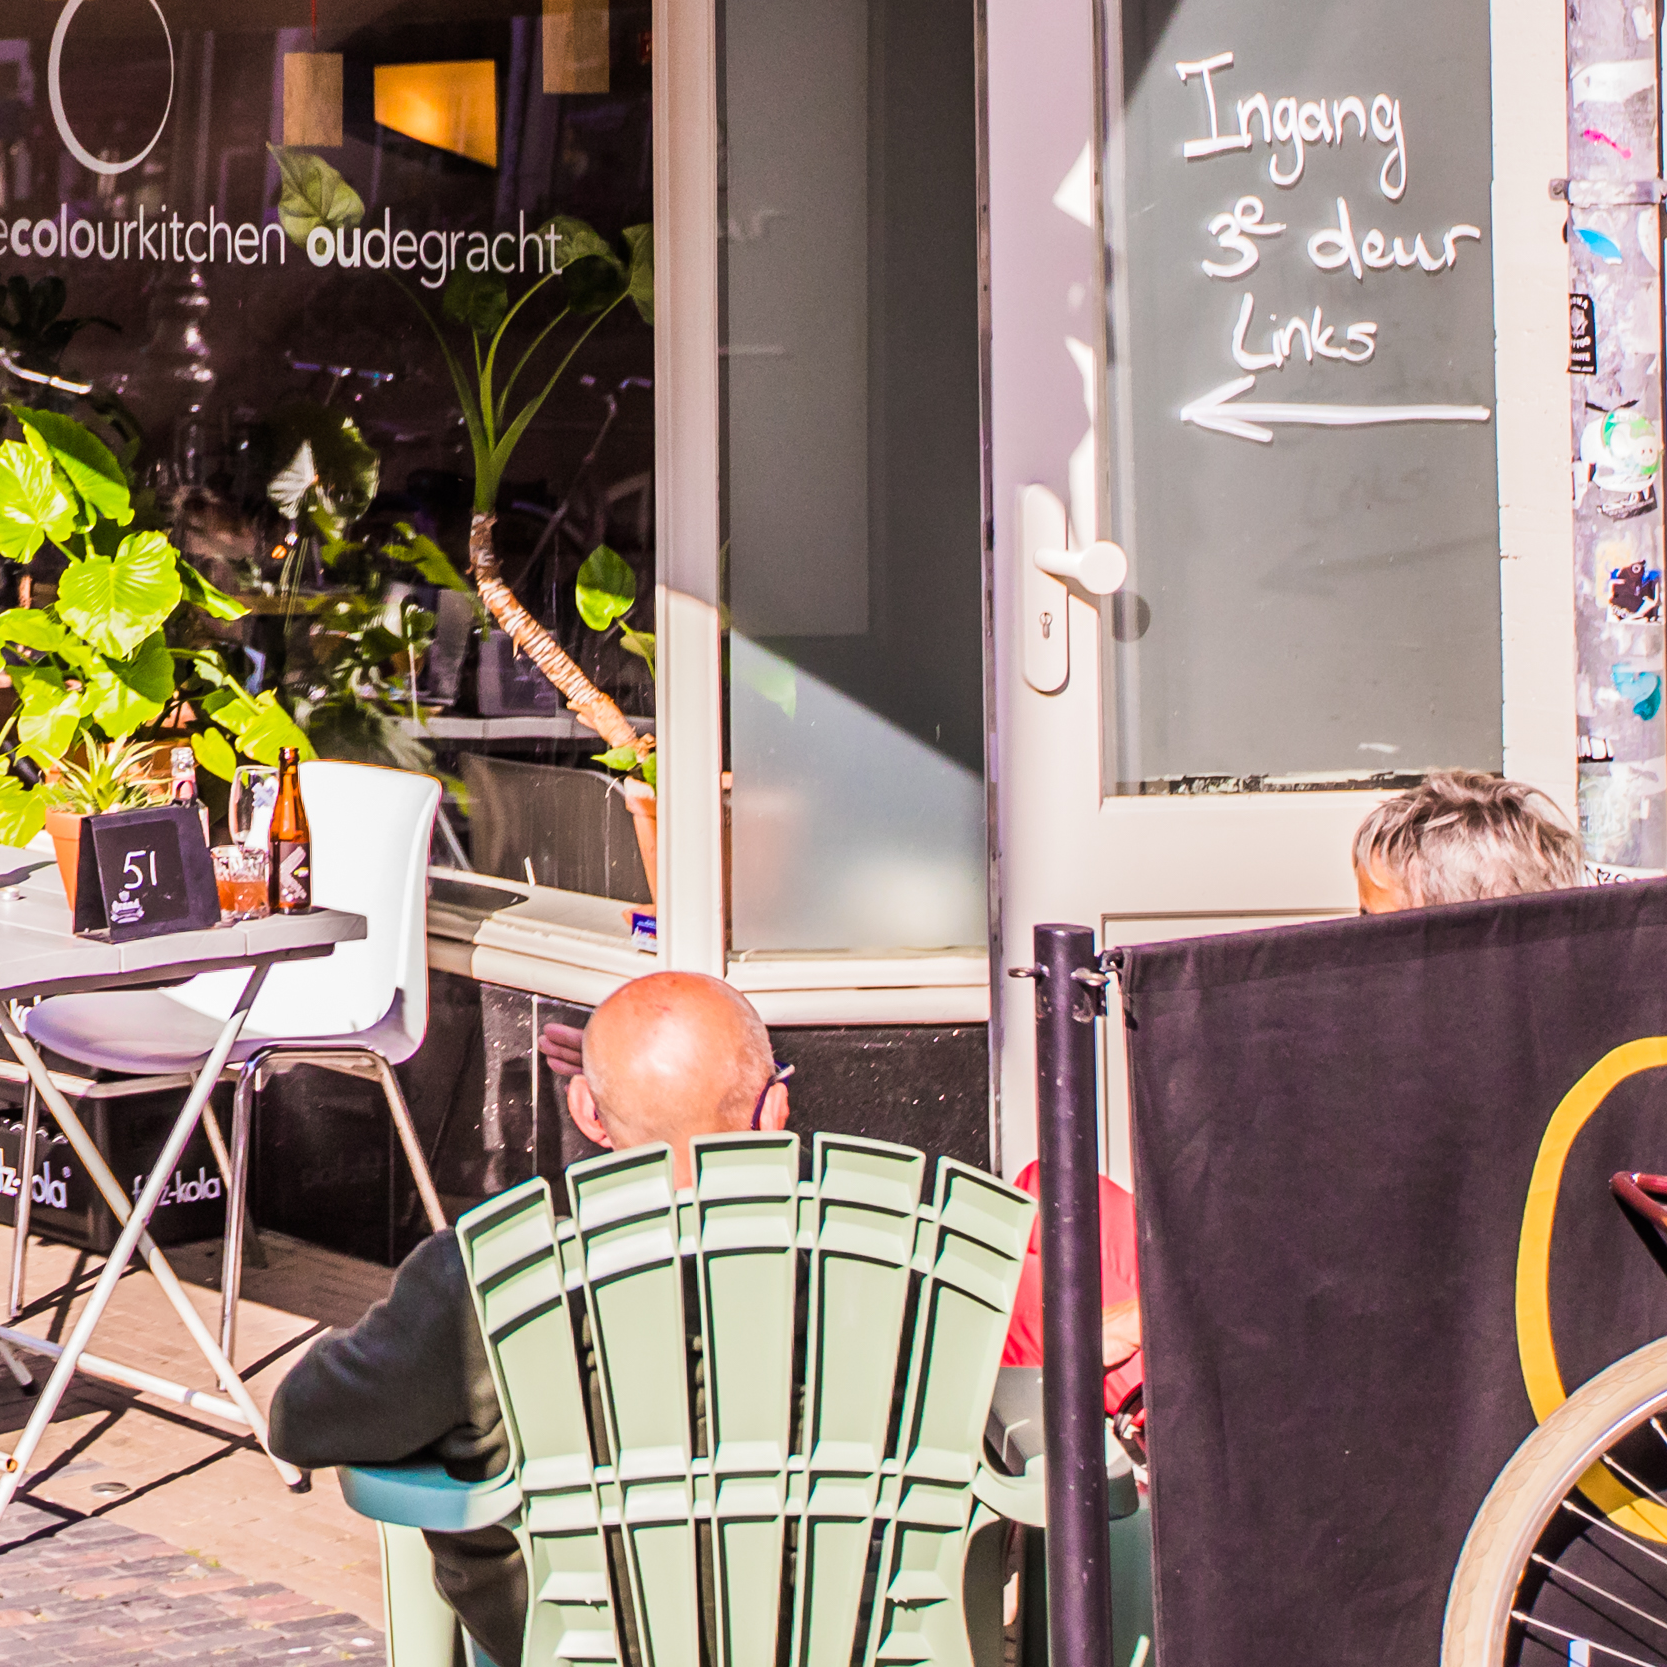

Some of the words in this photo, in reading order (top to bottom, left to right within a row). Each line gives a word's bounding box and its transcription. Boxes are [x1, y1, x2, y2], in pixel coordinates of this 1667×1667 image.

[1174, 51, 1407, 200] Ingang
[306, 206, 563, 289] oudegracht
[1307, 196, 1481, 280] deur
[1231, 291, 1378, 370] Links
[123, 850, 158, 890] 51
